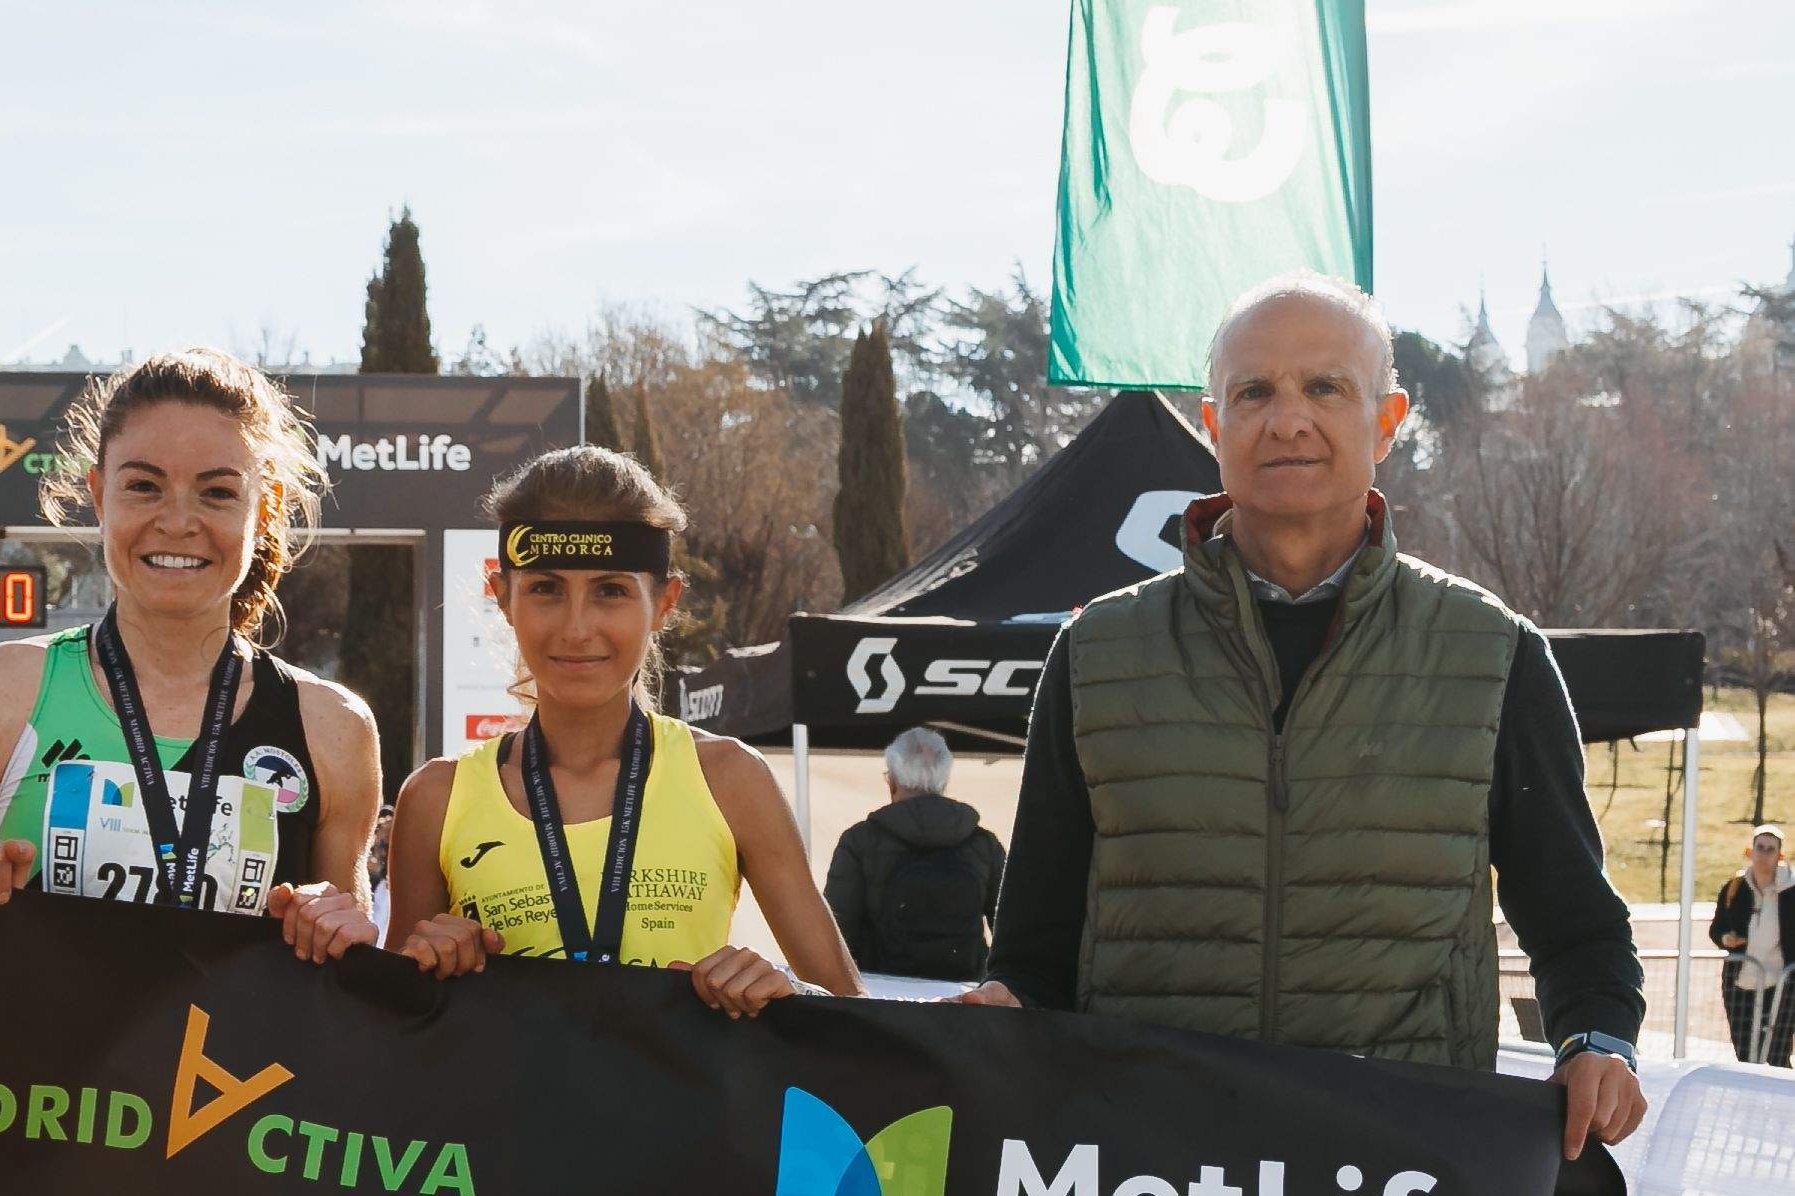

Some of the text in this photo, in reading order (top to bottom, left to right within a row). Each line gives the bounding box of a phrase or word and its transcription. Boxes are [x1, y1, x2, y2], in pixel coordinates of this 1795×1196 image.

[316, 434, 472, 471] MetLife
[529, 533, 612, 544] CENTRO CLINICO
[529, 544, 613, 556] MENORCA
[182, 847, 200, 893] MetLife
[630, 868, 708, 887] RKSHIRE
[483, 893, 551, 918] San Sebas
[503, 914, 523, 928] los
[524, 908, 558, 924] Reye
[640, 917, 675, 932] Spain
